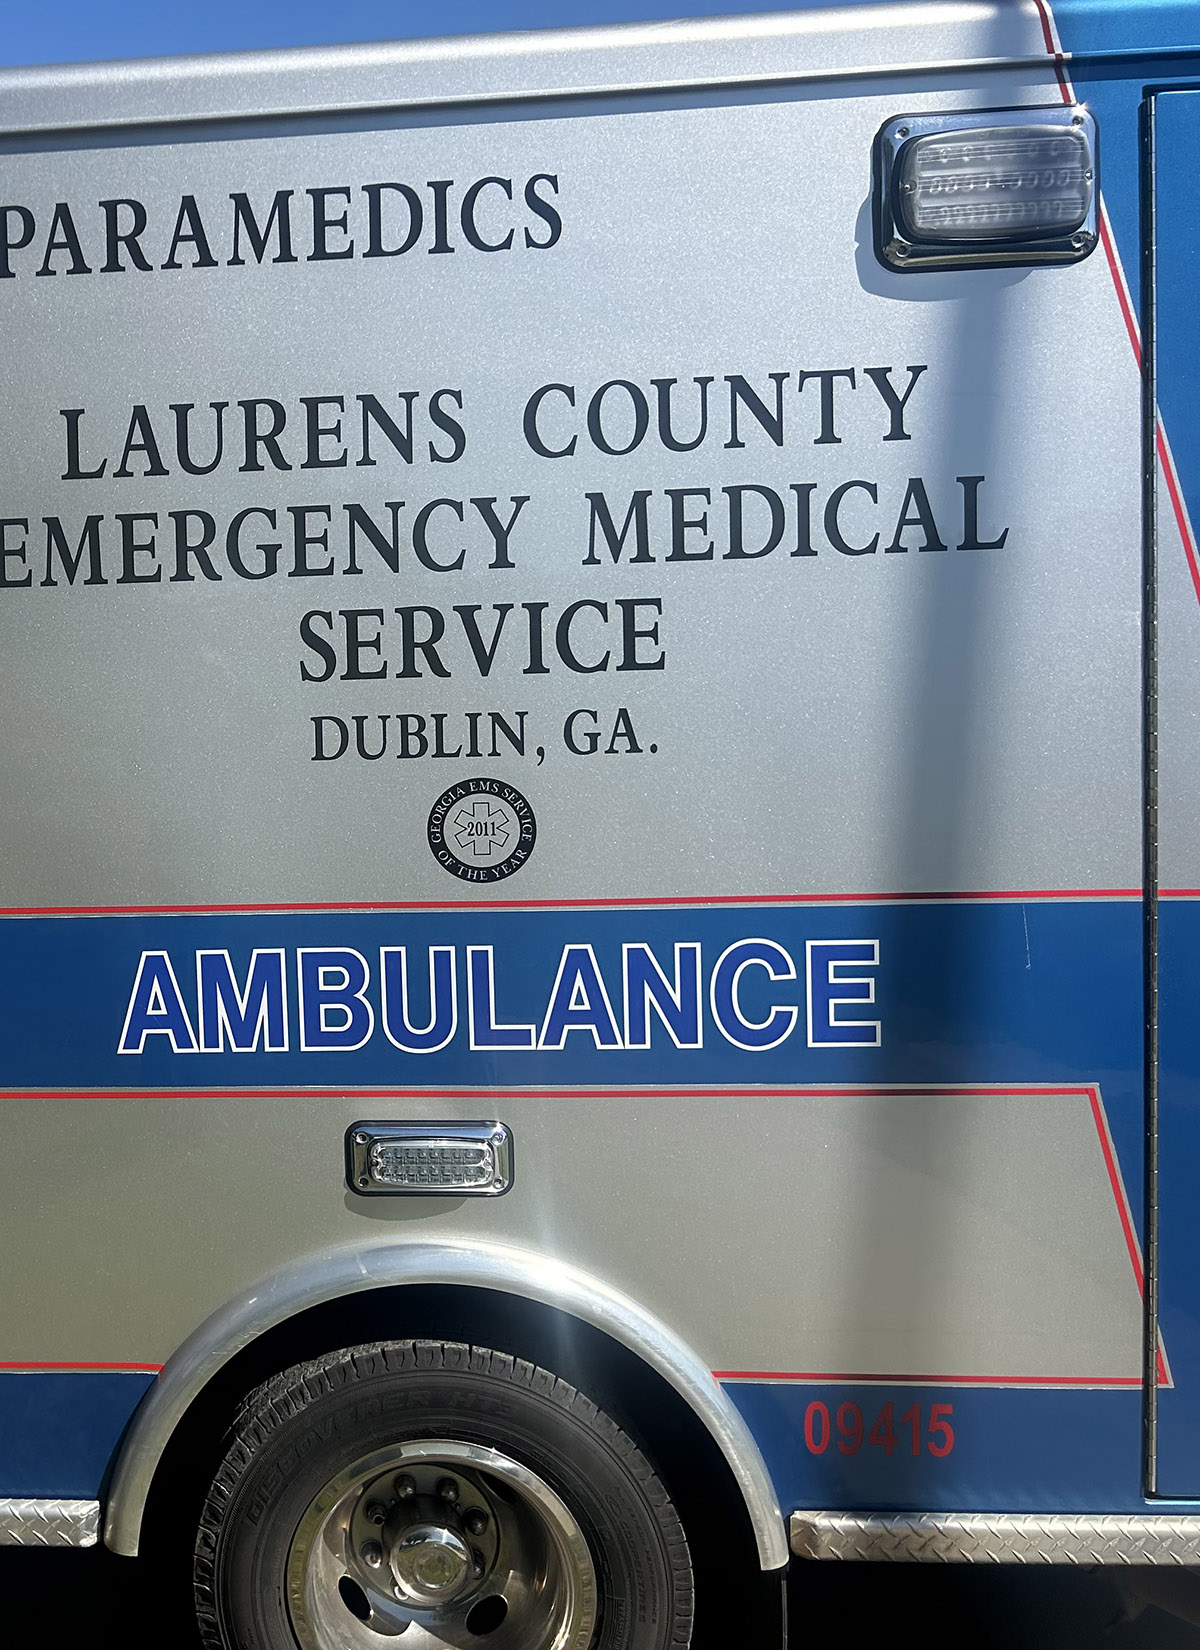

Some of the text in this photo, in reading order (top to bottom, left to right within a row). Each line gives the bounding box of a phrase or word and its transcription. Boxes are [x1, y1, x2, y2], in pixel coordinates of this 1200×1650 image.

[60, 365, 927, 480] LAURENS COUNTY
[582, 475, 1009, 566] MEDICAL
[299, 598, 666, 682] SERVICE
[310, 707, 658, 766] DUBLIN, GA.
[431, 781, 533, 843] GEORGIA EMS SERVICE
[467, 821, 497, 837] 2011
[437, 848, 528, 881] OF THE YEAR
[116, 938, 881, 1054] AMBULANCE
[803, 1400, 955, 1457] 09415
